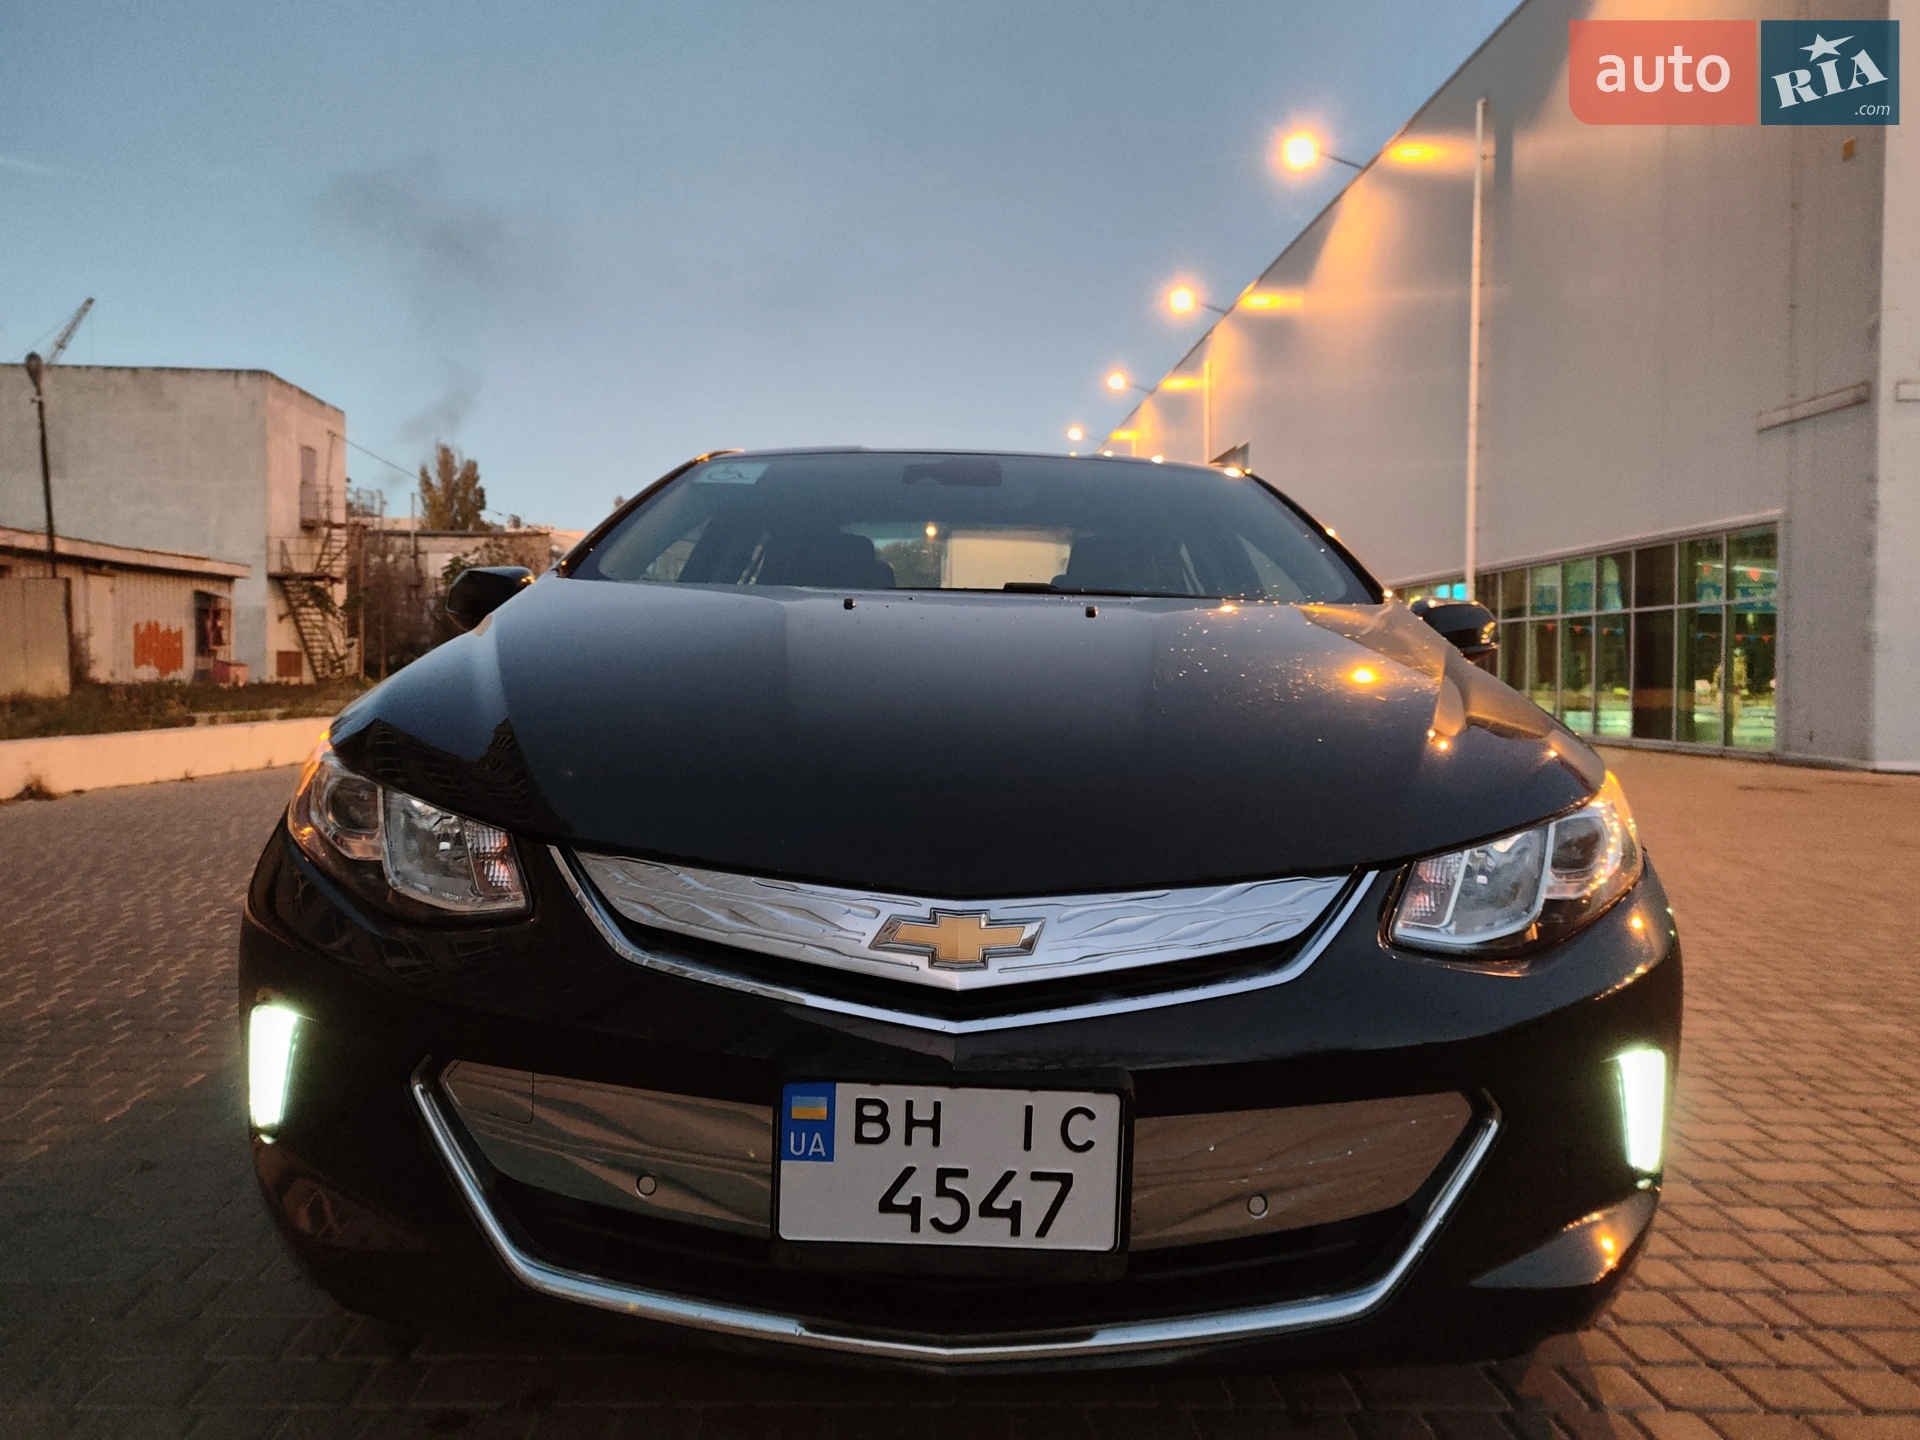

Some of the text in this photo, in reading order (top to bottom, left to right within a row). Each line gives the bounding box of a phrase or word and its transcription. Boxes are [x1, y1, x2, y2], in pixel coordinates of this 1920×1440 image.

[790, 1131, 826, 1158] UA
[854, 1097, 942, 1147] BH
[878, 1165, 1074, 1238] 4547
